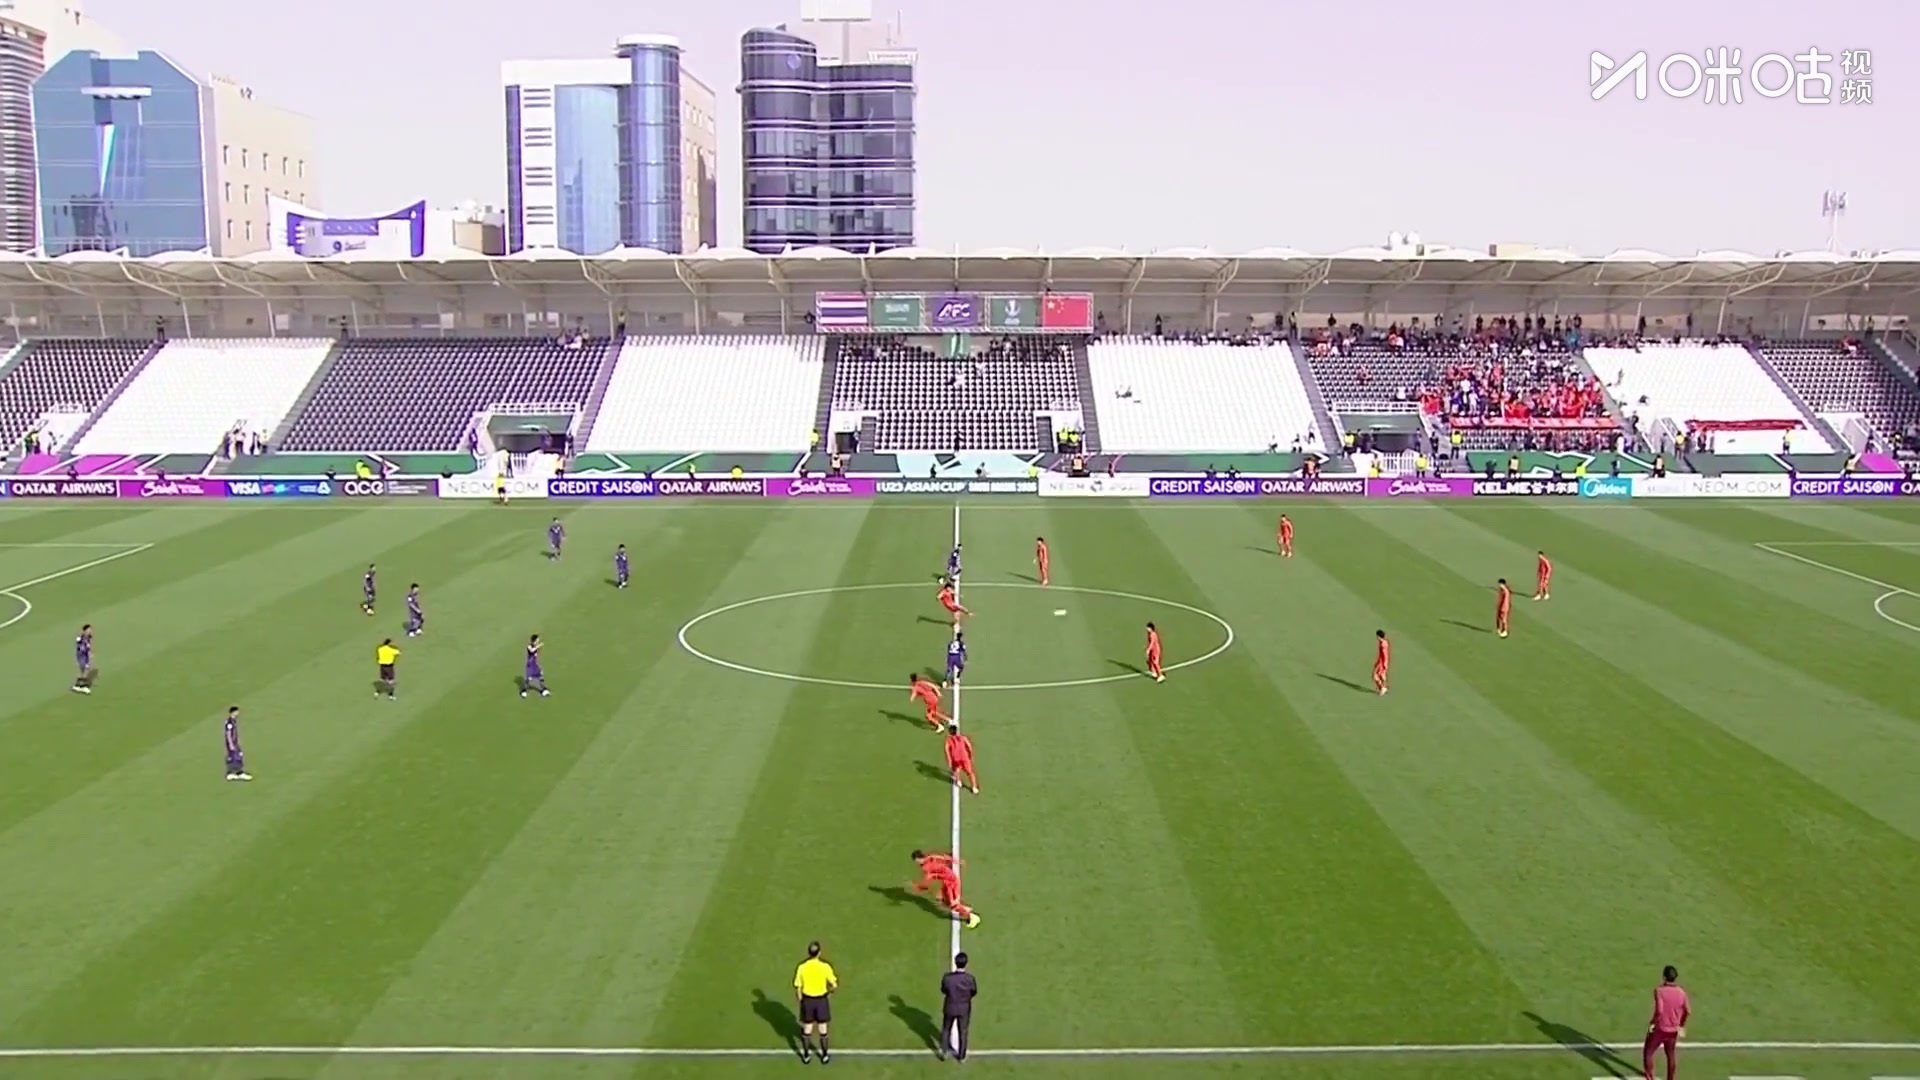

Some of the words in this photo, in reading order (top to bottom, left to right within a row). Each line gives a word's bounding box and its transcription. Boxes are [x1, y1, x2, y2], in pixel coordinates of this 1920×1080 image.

[939, 303, 970, 317] AFC
[12, 482, 56, 494] QATAR
[61, 482, 115, 494] AIRWAYS
[228, 482, 261, 494] VISA
[449, 482, 495, 493] NEOM
[550, 481, 599, 494] CREDIT
[601, 481, 653, 494] SAISON
[659, 481, 702, 493] QATAR
[706, 481, 761, 493] AIRWAYS
[882, 482, 904, 492] U23
[904, 482, 940, 492] ASIAN
[942, 482, 967, 492] CUP
[1152, 480, 1201, 493] CREDIT
[1203, 480, 1255, 493] SAISON
[1261, 481, 1304, 493] QATAR
[1308, 481, 1363, 493] AIRWAYS
[1473, 481, 1531, 494] KELME
[1584, 478, 1627, 497] Midea
[1693, 482, 1739, 493] NEOM
[1793, 481, 1841, 494] CREDIT
[1843, 481, 1893, 494] SAISON
